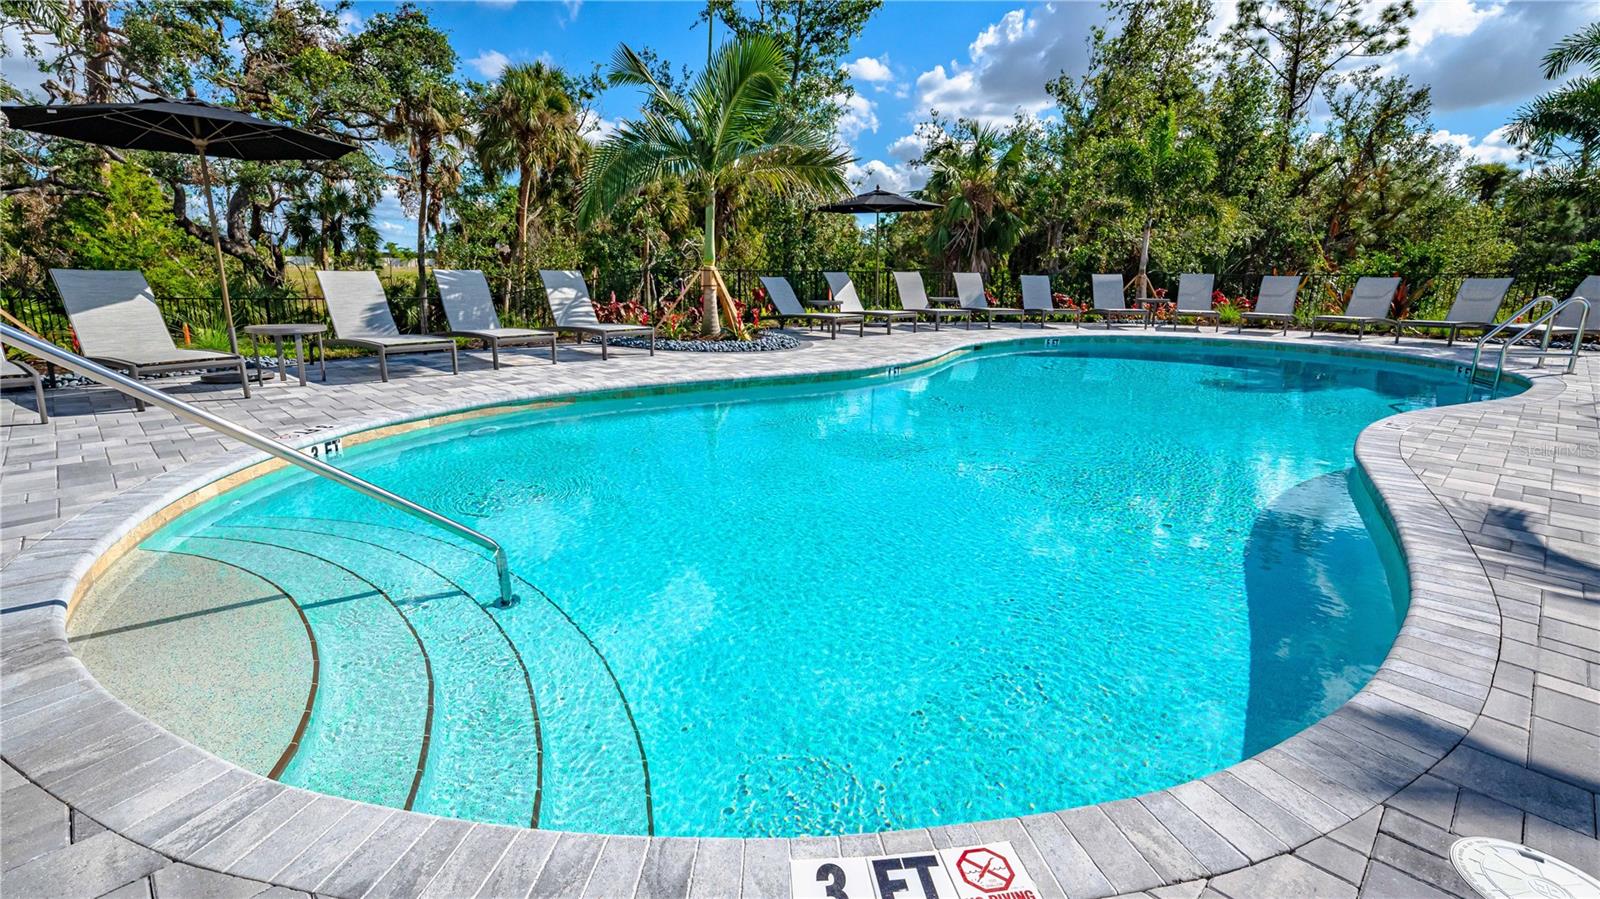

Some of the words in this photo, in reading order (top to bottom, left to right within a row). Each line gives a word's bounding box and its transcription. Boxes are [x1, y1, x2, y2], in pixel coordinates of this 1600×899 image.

[324, 439, 338, 454] FT
[816, 863, 848, 899] 3
[871, 855, 939, 899] FT
